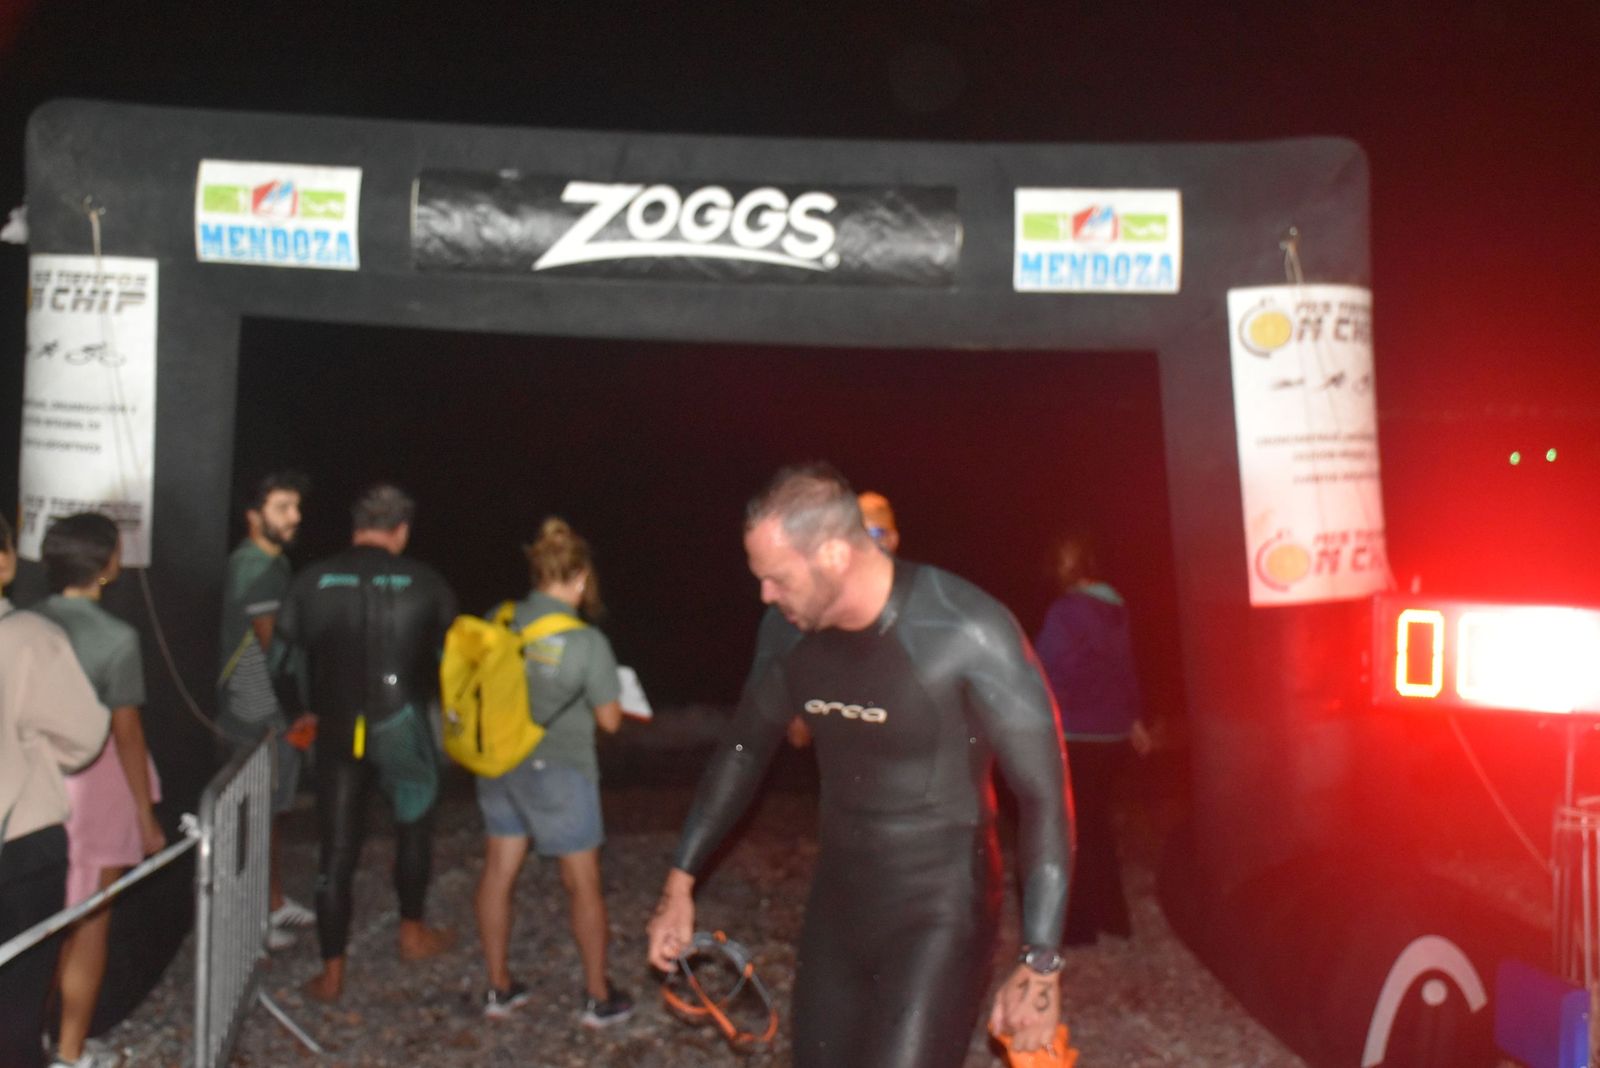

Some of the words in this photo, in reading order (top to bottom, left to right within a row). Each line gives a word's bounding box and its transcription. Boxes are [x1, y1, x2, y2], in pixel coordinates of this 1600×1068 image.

[200, 223, 354, 264] MENDOZA
[532, 181, 837, 272] ZOGGS
[1020, 252, 1176, 287] MENDOZA
[52, 287, 146, 314] CHIP
[804, 699, 888, 724] orca
